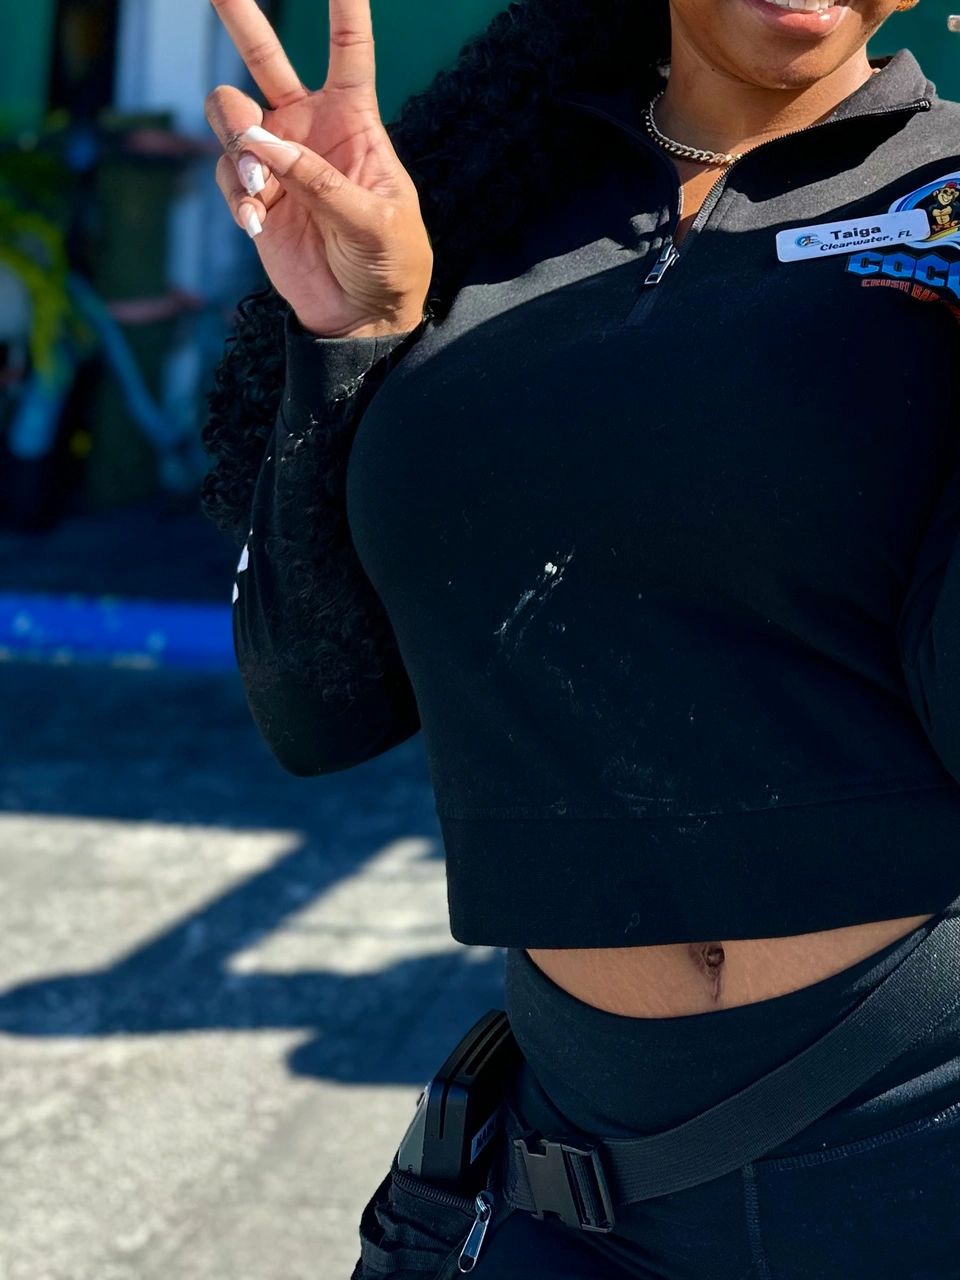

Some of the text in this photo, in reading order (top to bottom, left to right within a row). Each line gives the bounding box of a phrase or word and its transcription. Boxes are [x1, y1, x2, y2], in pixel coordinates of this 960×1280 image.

[820, 230, 913, 252] Clearwater, FL
[830, 225, 882, 241] Taiga
[861, 278, 911, 294] CRUSH
